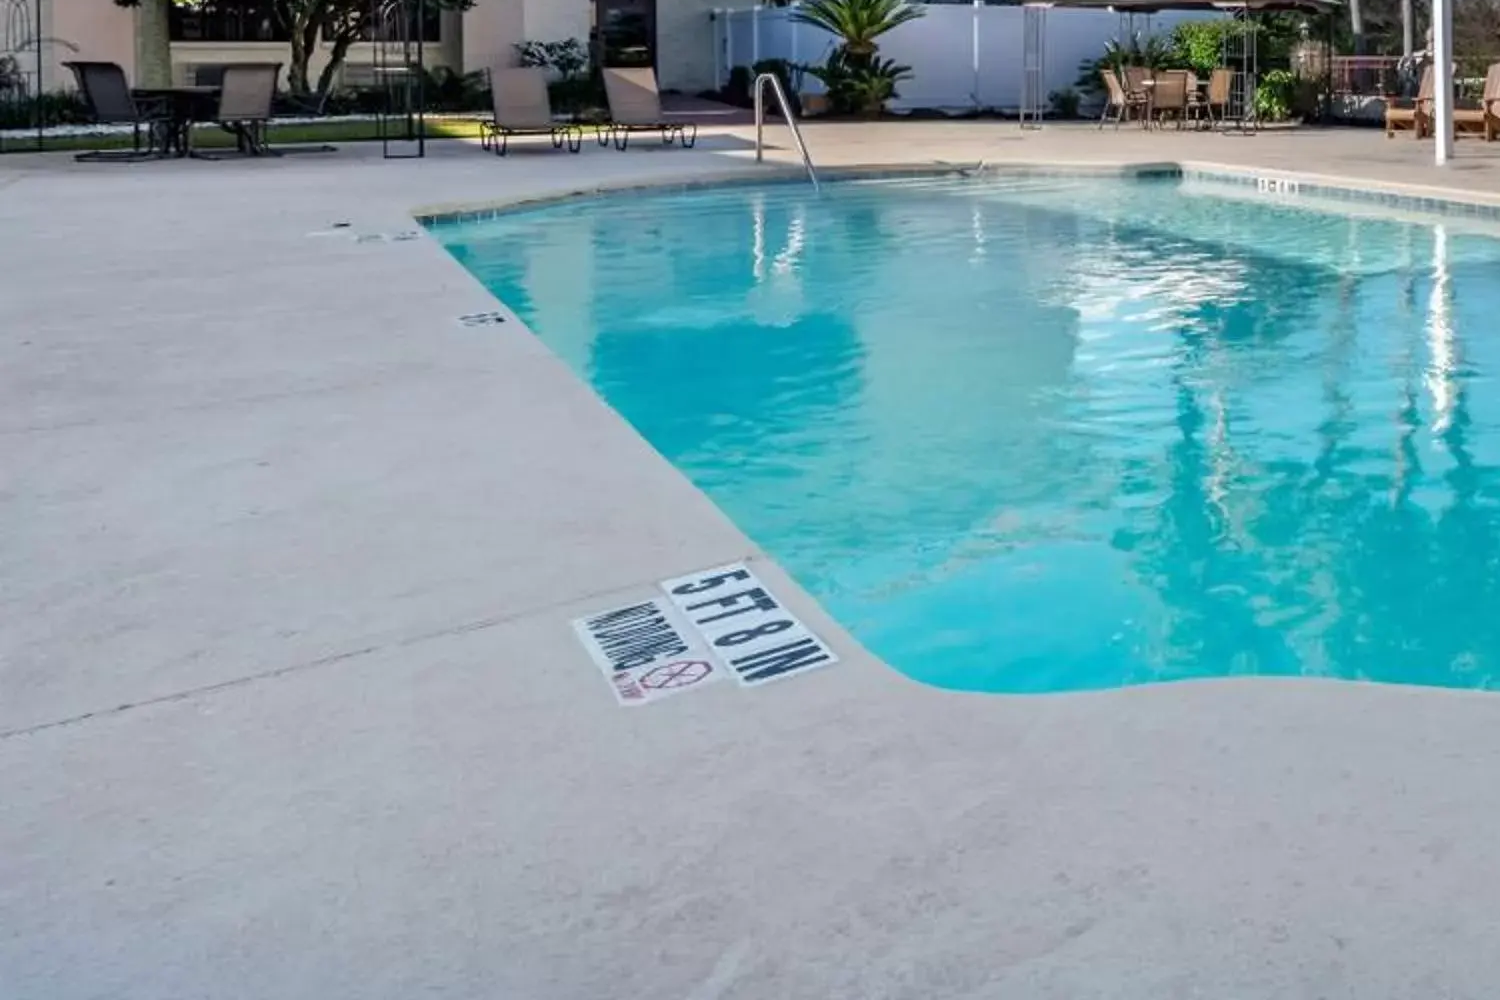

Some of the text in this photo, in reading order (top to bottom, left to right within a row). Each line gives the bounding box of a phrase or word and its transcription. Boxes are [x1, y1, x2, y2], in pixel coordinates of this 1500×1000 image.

[671, 568, 830, 683] 5 FT 8 IN
